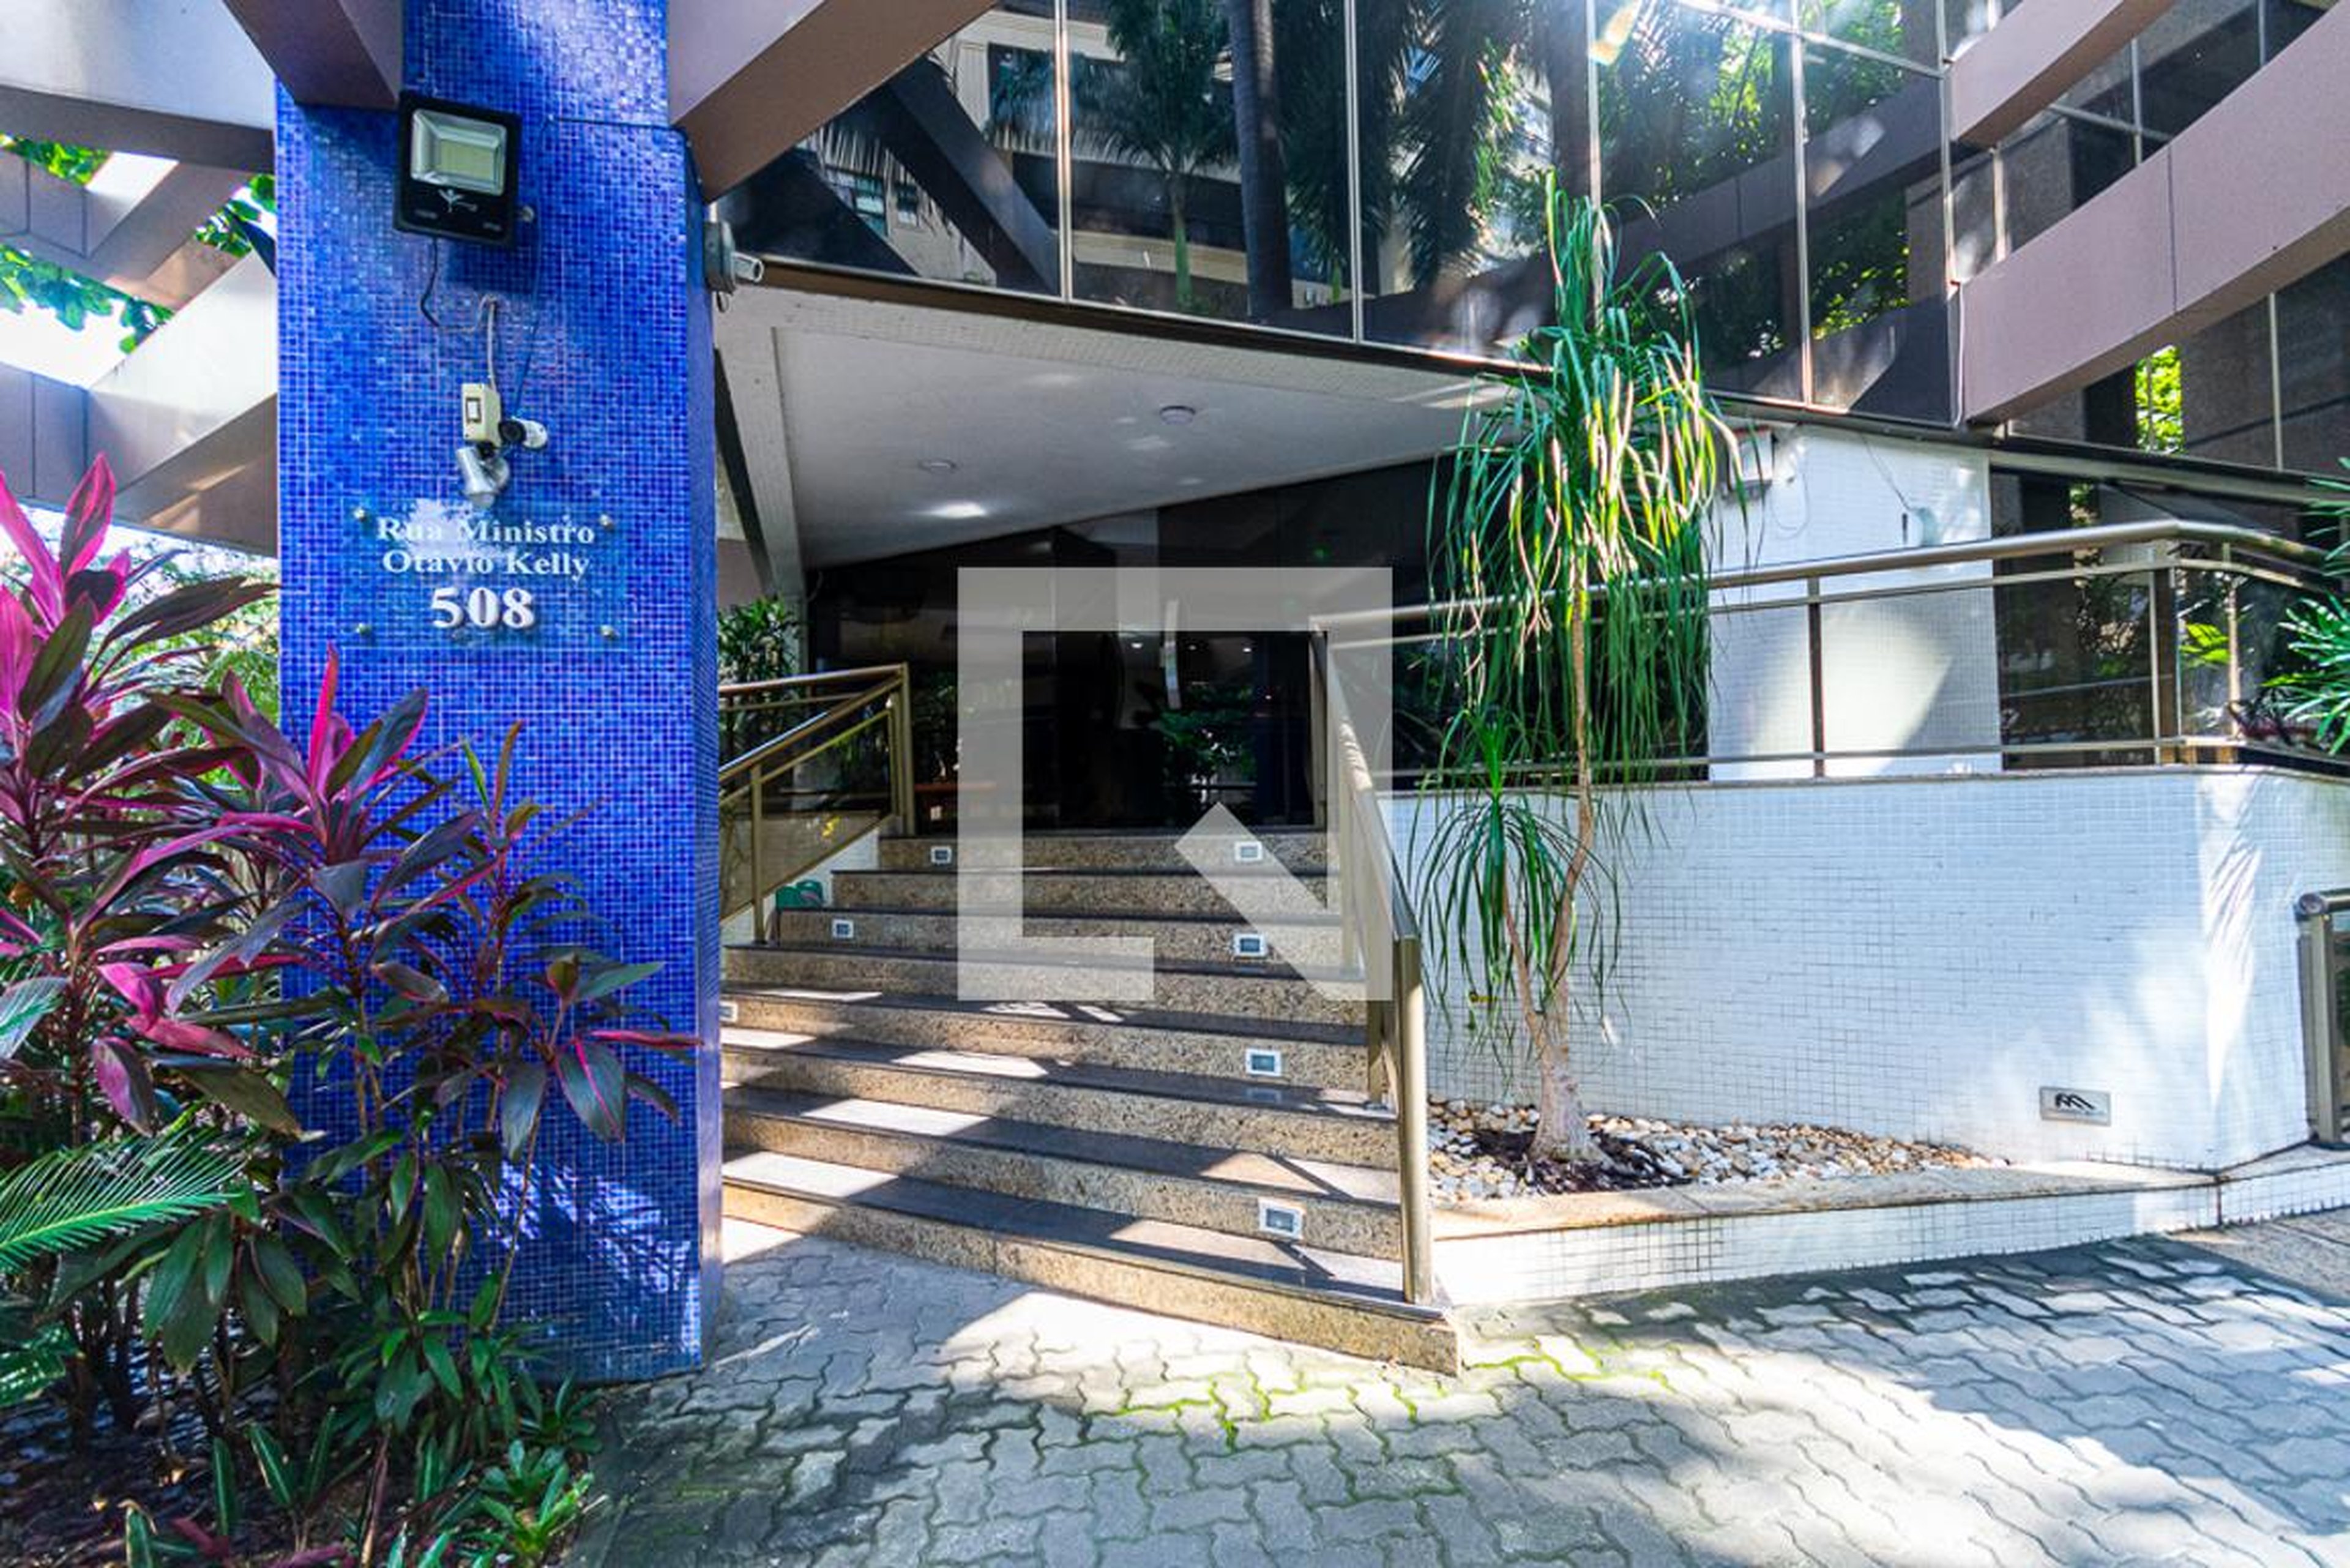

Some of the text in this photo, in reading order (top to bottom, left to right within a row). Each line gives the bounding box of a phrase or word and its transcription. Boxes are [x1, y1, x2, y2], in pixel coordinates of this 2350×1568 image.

[375, 517, 595, 543] Rua Ministro
[502, 551, 589, 583] Kelly
[431, 586, 535, 629] 508
